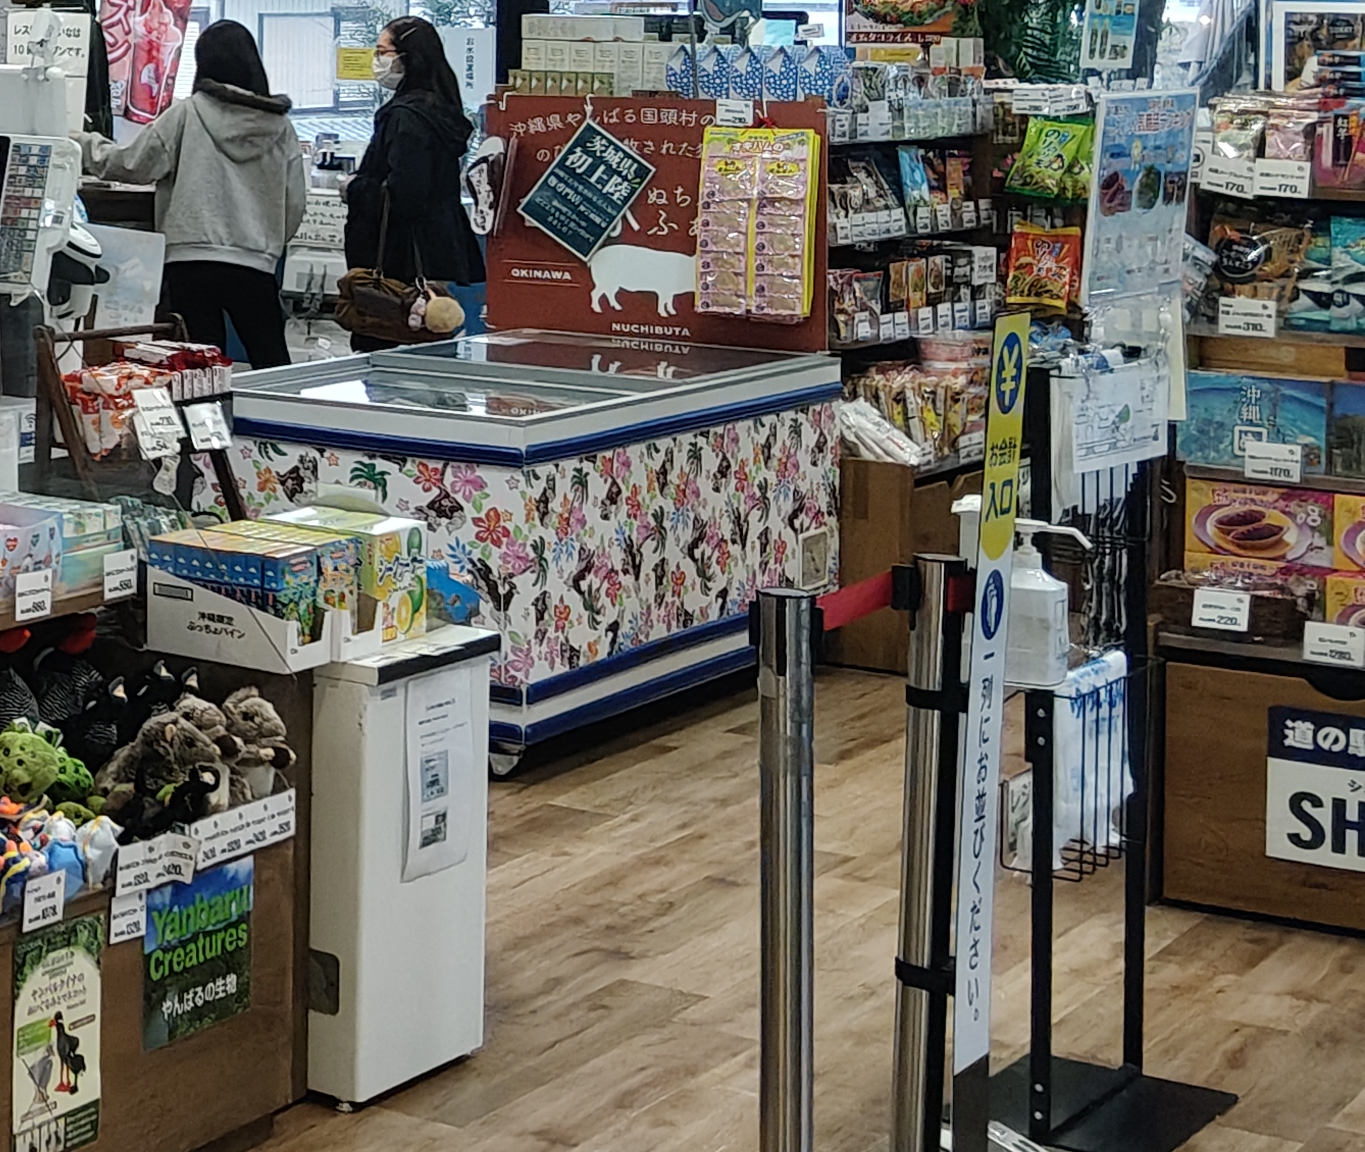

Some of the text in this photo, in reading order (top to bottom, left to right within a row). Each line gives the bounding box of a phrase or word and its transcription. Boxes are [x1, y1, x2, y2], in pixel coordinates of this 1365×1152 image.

[510, 268, 573, 282] OKINAWA
[611, 322, 692, 338] NUCHIBUTA
[1240, 386, 1263, 425] 沖縄
[988, 436, 1019, 468] お会計
[985, 477, 1015, 524] 入口
[152, 884, 252, 945] Yanbaru
[148, 921, 250, 983] Creatures
[160, 971, 238, 1021] やんばるの生物
